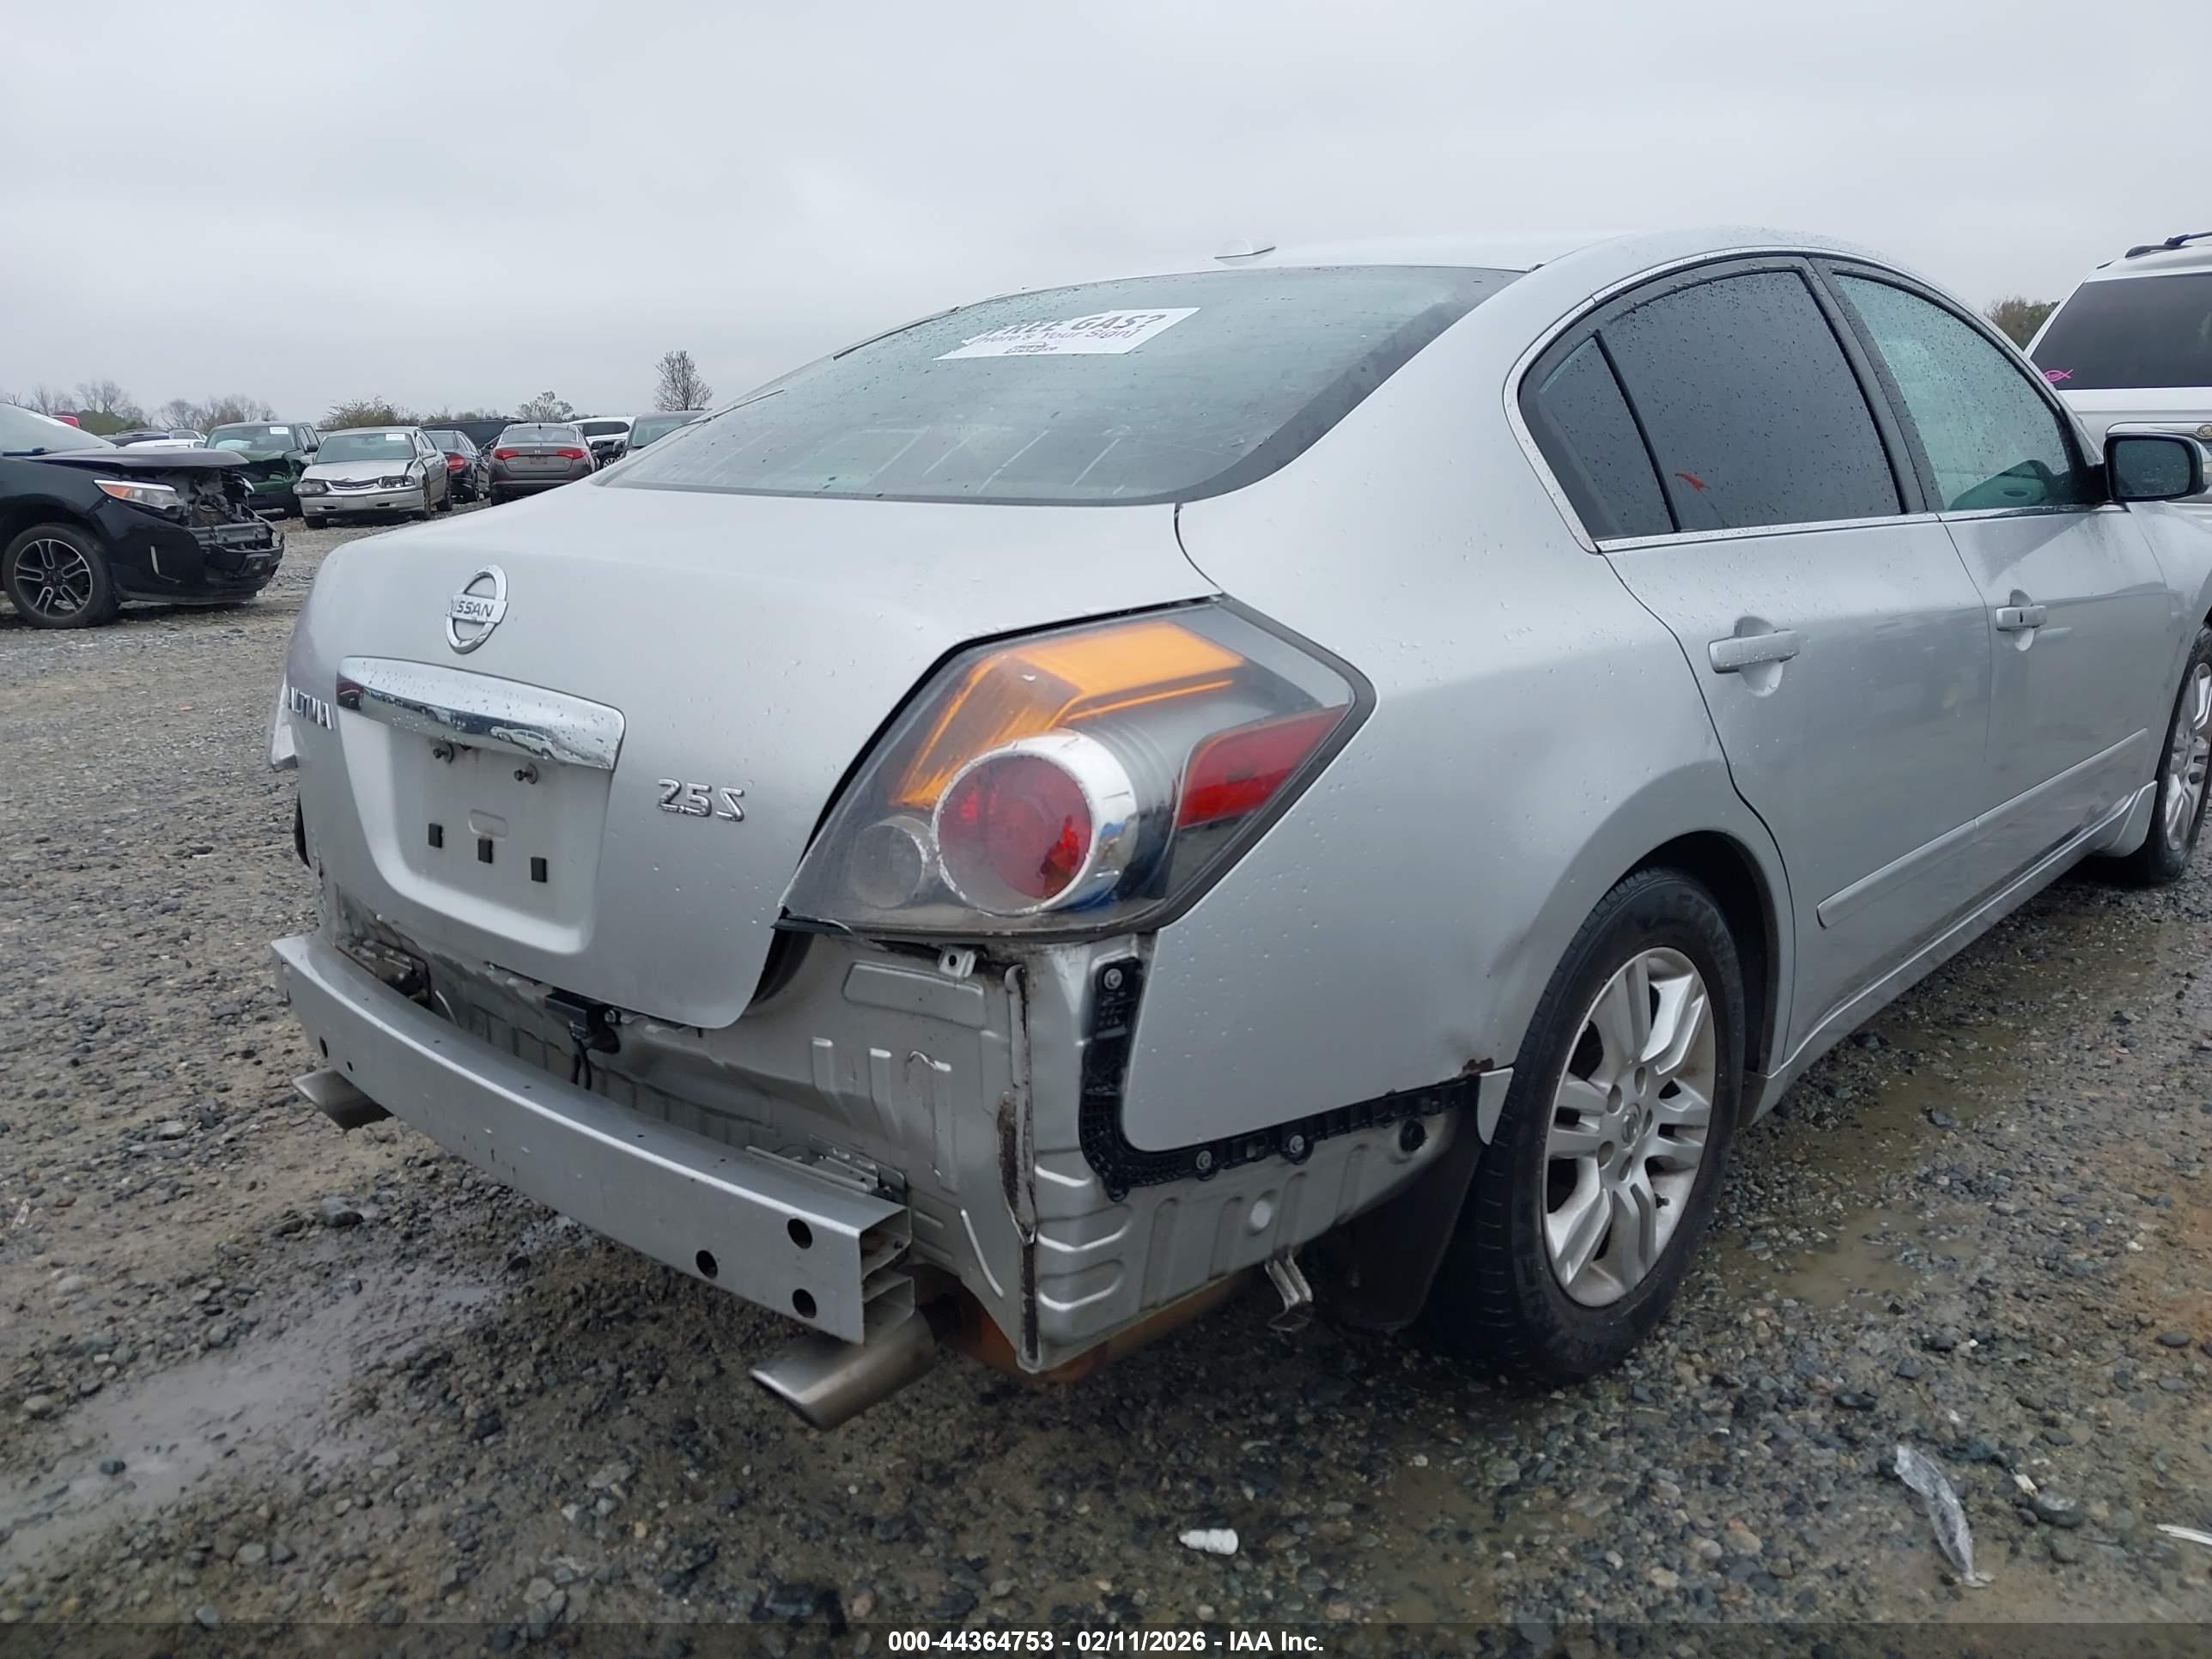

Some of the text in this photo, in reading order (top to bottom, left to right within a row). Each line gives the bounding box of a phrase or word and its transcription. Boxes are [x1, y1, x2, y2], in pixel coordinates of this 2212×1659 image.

[1071, 314, 1167, 331] GAS?
[449, 598, 495, 618] NISSAN
[716, 787, 745, 822] S
